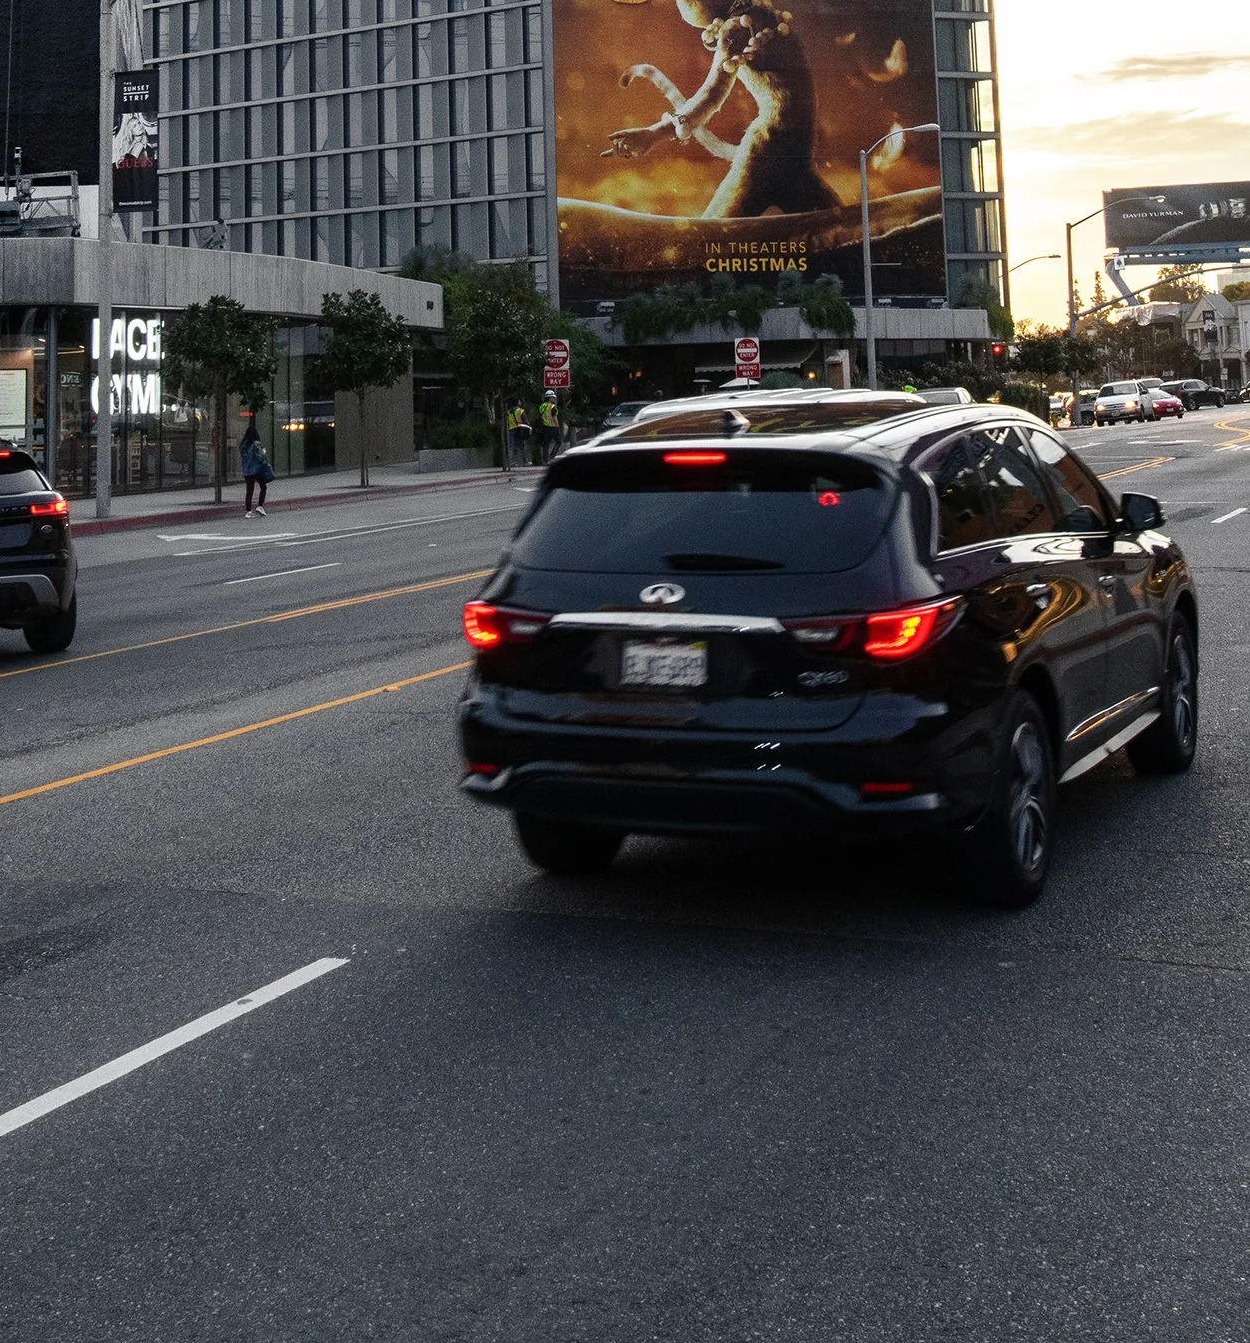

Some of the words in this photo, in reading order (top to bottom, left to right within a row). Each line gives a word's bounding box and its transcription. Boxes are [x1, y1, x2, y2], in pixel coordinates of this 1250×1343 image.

[123, 84, 149, 92] SUNSET
[123, 94, 150, 102] STRIP
[705, 242, 721, 254] IN
[728, 241, 807, 254] THEATERS
[705, 257, 808, 272] CHRISTMAS
